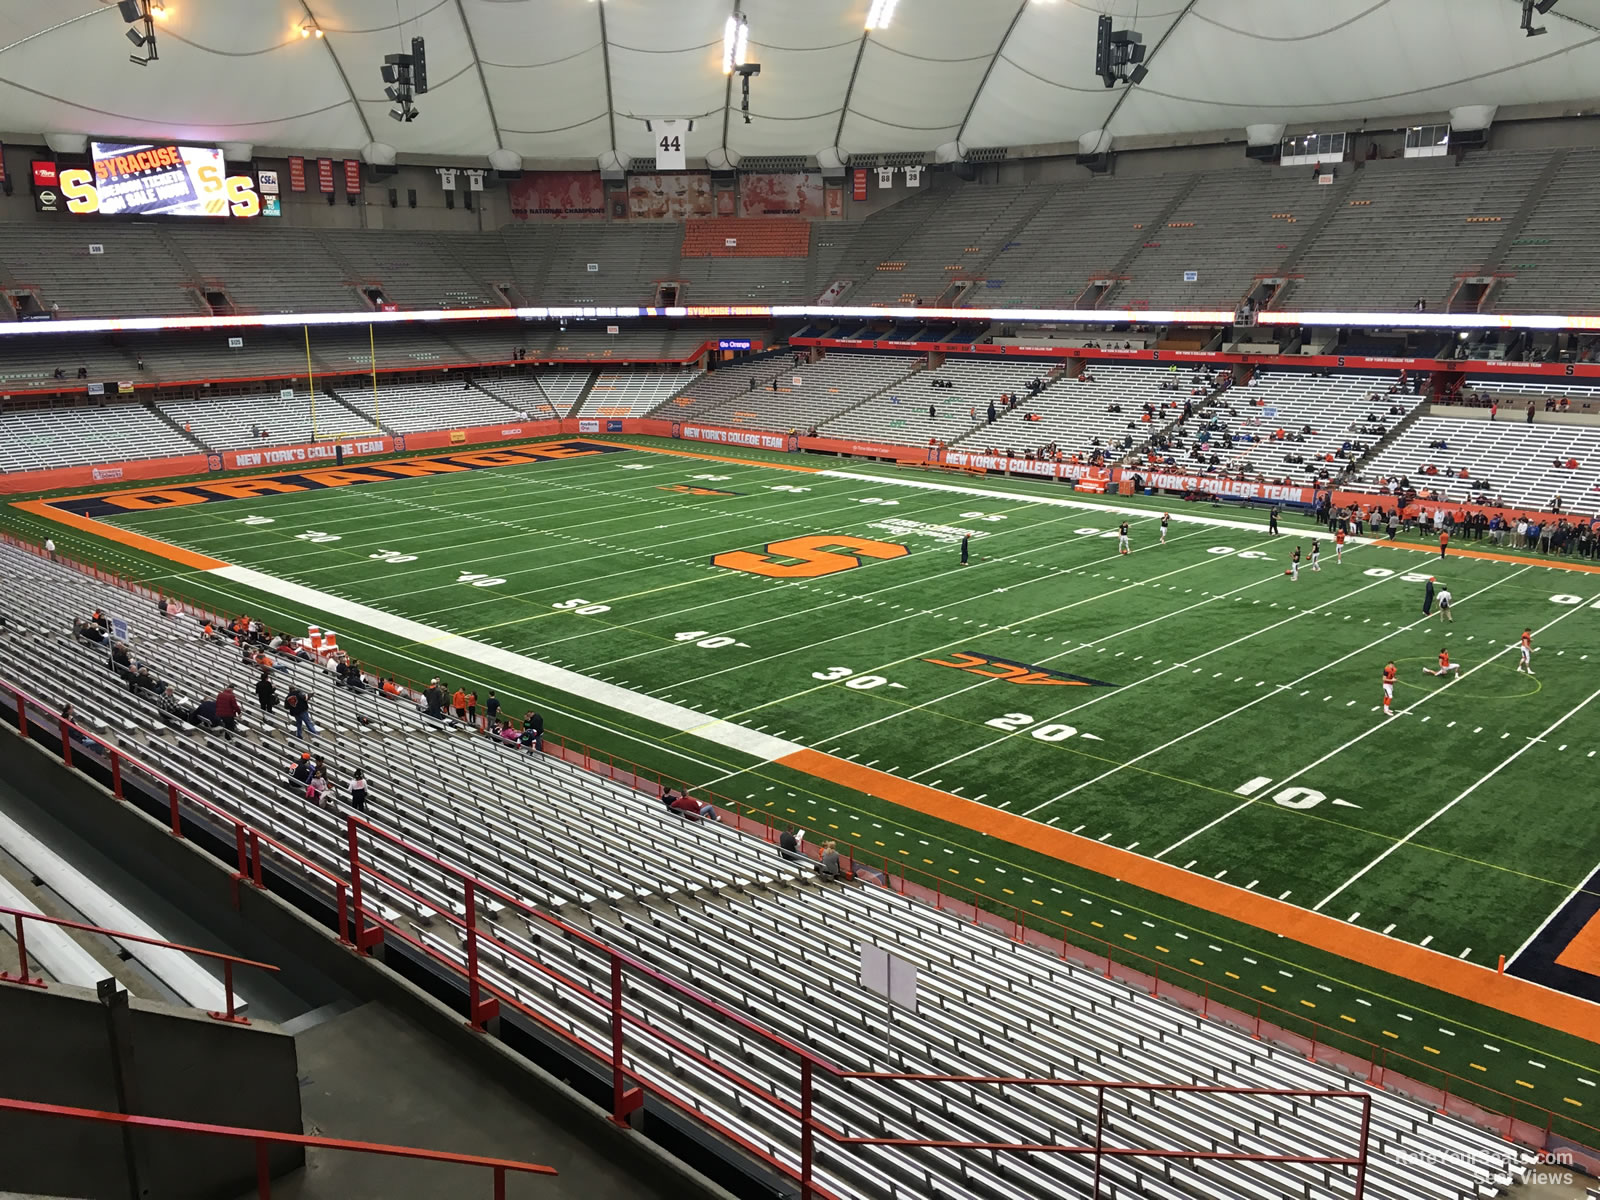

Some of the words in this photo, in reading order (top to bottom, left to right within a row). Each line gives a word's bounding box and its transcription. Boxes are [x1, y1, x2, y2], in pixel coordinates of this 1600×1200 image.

[660, 136, 681, 152] 44
[94, 146, 182, 179] SYRACUSE
[260, 175, 276, 184] CSEA
[59, 169, 98, 214] S
[225, 175, 260, 217] S
[688, 307, 729, 316] SYRACUSE
[1566, 365, 1574, 375] S
[684, 427, 700, 438] NEW
[701, 429, 726, 442] YORK'S
[728, 432, 760, 445] COLLEGE
[762, 436, 782, 448] TEAM
[209, 455, 221, 470] S
[236, 454, 262, 466] NEW
[264, 449, 305, 464] YORK'S
[355, 440, 384, 453] TEAM
[102, 442, 605, 510] ORANGE
[946, 452, 968, 465] NEW
[970, 455, 1007, 470] YORK'S
[1009, 460, 1056, 476] COLLEGE
[1060, 465, 1090, 479] TEAM
[1150, 474, 1197, 490] YORK'S
[1200, 478, 1259, 498] COLLEGE
[1263, 485, 1302, 502] TEAM
[294, 532, 342, 542] 20
[369, 550, 418, 564] 30
[711, 534, 912, 578] S
[456, 574, 506, 588] 40
[552, 598, 612, 614] 50
[674, 630, 736, 648] 40
[812, 666, 888, 690] 30
[984, 713, 1078, 742] 20
[1233, 776, 1327, 810] 10
